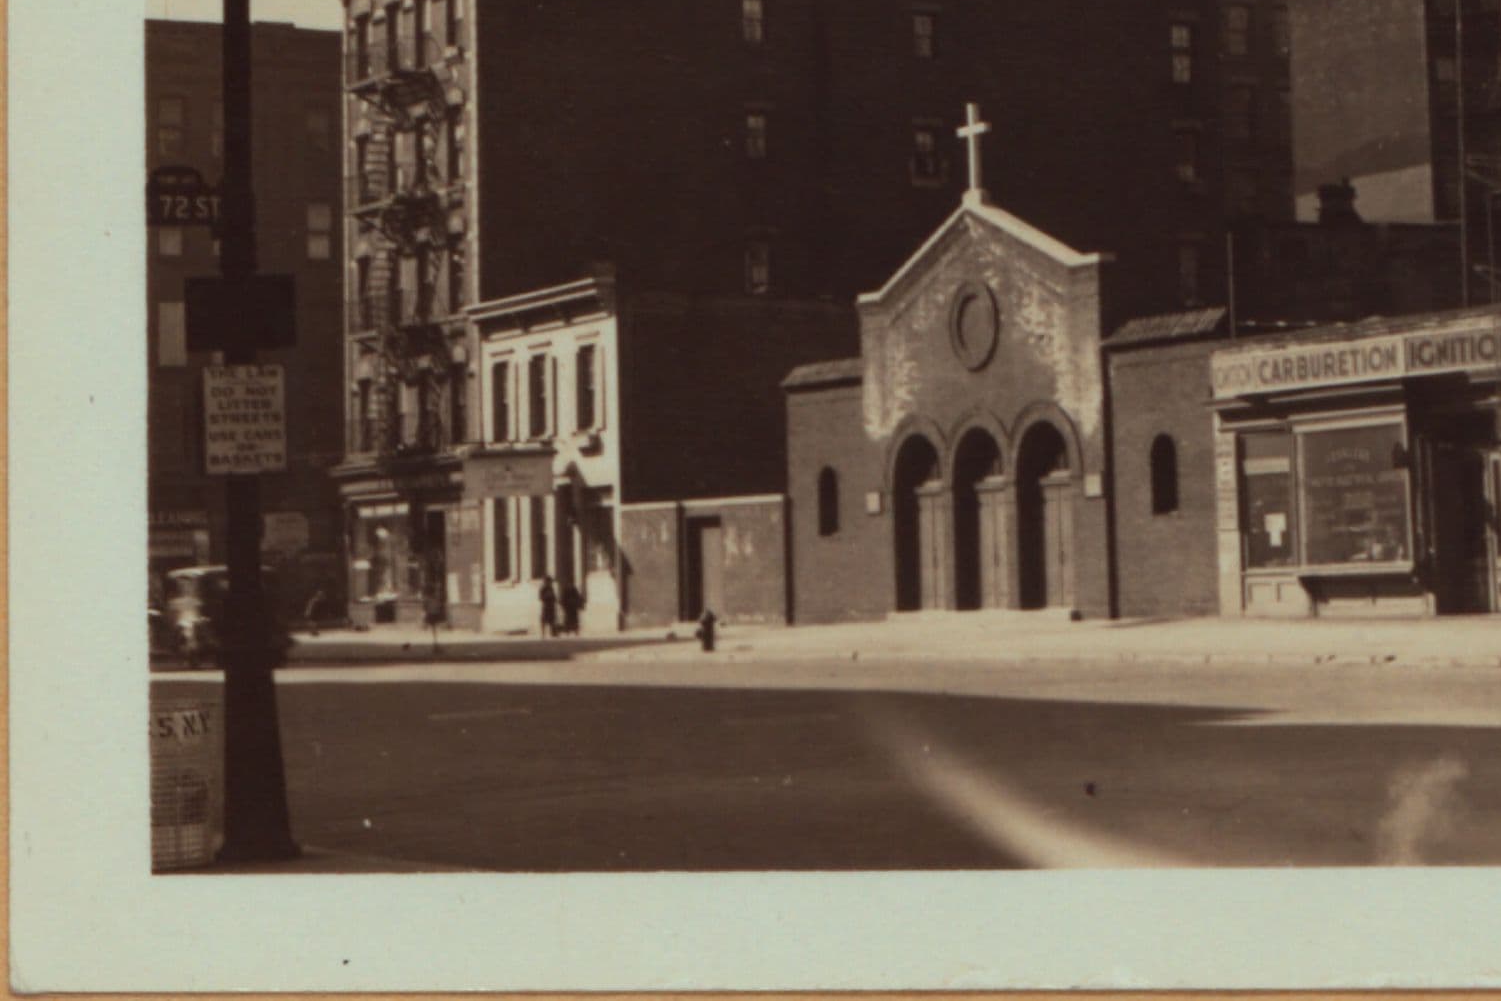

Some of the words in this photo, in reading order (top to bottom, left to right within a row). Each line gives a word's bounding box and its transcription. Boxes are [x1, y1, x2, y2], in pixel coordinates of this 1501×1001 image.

[160, 195, 189, 219] 72
[195, 195, 222, 220] ST
[1257, 344, 1398, 385] CARBURETION
